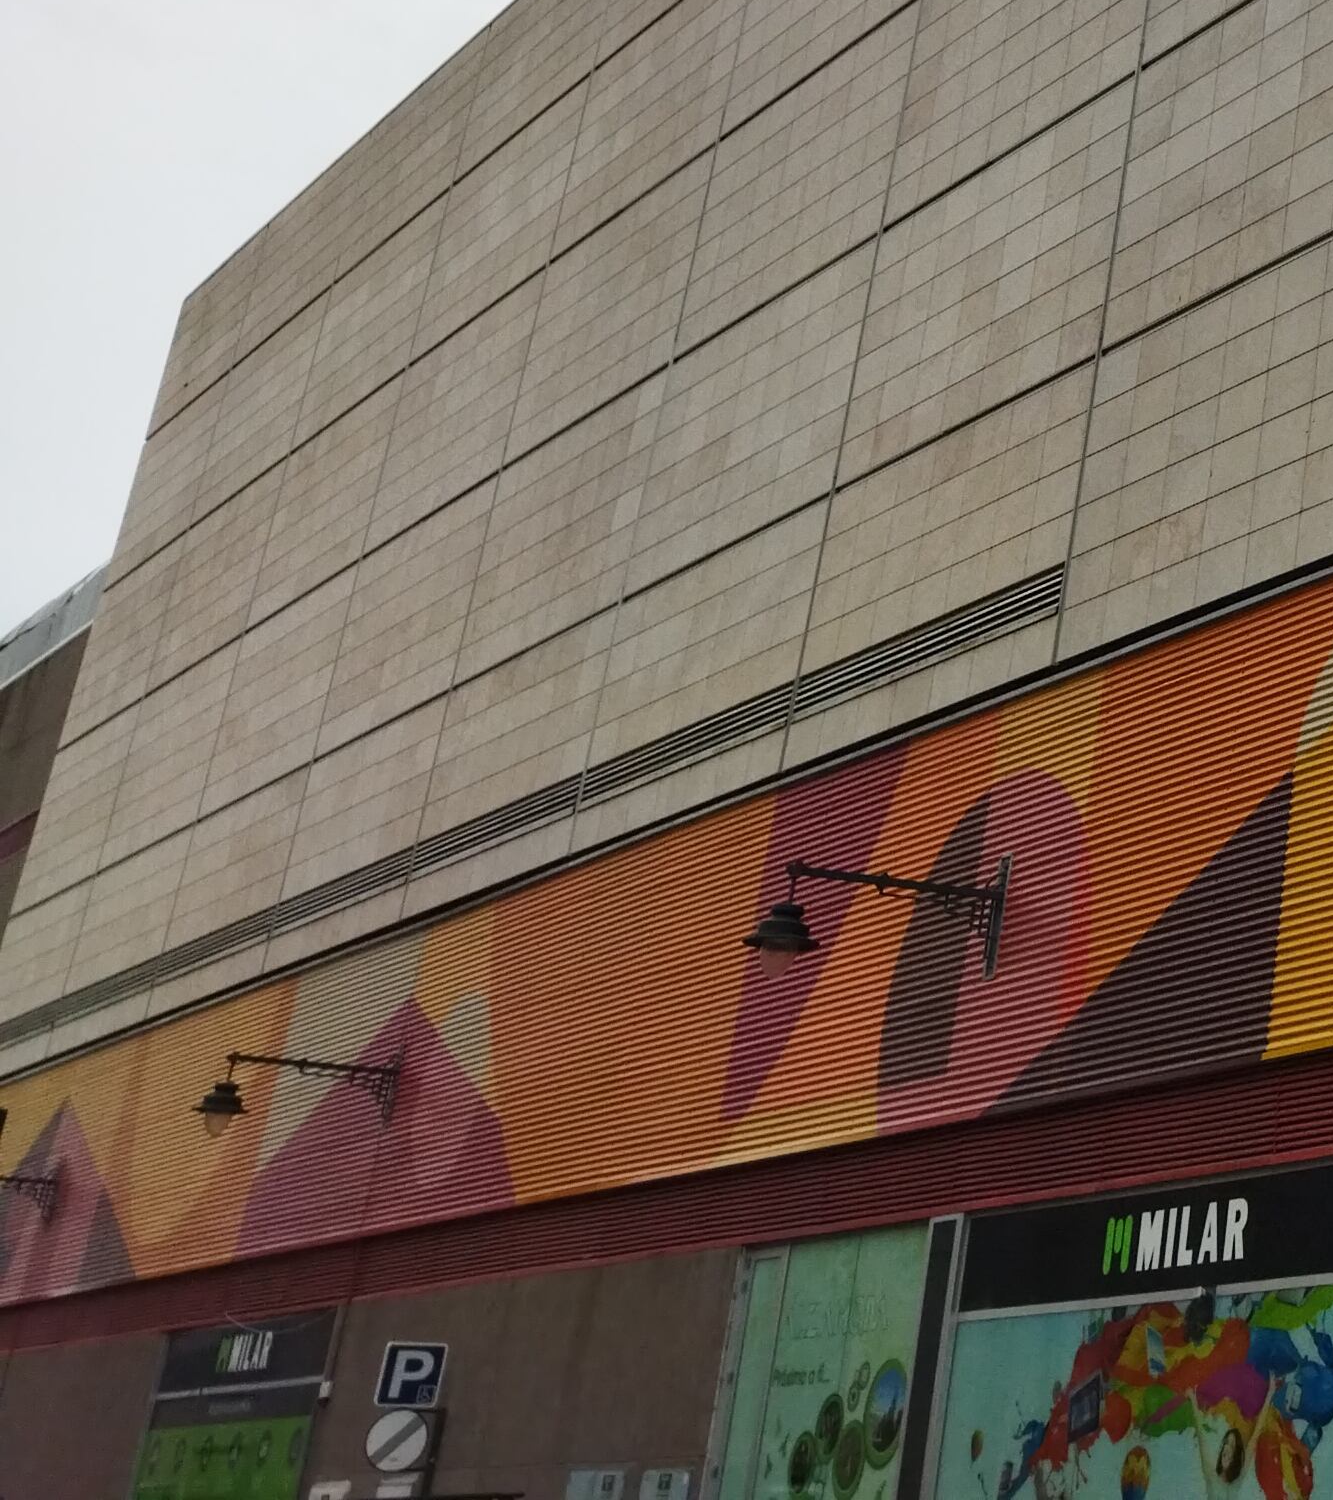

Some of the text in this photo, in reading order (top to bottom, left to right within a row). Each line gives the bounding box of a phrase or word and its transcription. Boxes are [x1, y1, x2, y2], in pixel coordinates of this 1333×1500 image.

[1135, 1197, 1250, 1273] MILAR
[227, 1331, 273, 1373] MILAR
[387, 1349, 435, 1399] P
